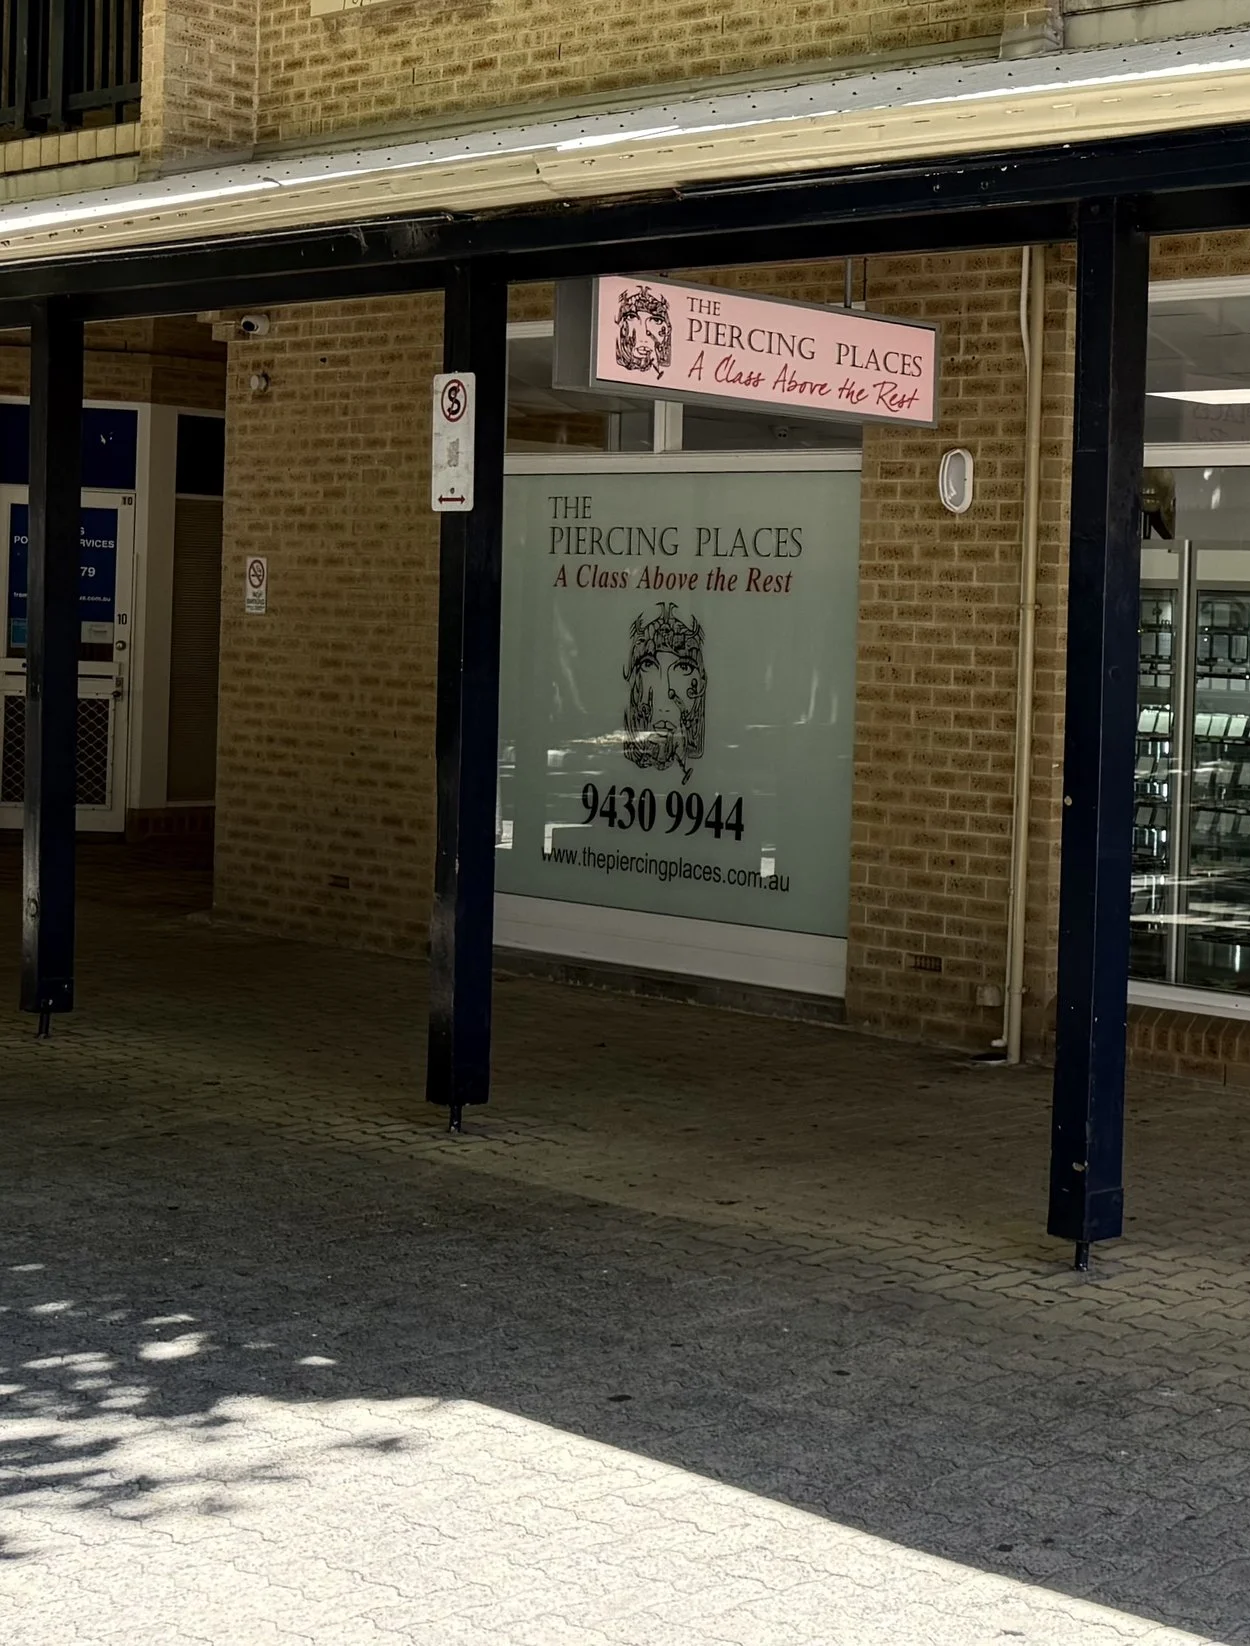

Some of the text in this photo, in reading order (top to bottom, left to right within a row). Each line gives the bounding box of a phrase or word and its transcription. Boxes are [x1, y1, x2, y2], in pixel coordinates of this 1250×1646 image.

[687, 297, 721, 316] THE
[686, 317, 923, 378] PIERCING PLACES
[688, 350, 921, 413] A Class Above the Rest
[548, 496, 592, 520] THE
[14, 535, 115, 549] PO RVICES
[548, 526, 803, 558] PIERCING PLACES
[80, 566, 96, 577] 79
[553, 564, 793, 593] A Class Above the Rest
[117, 613, 128, 625] 10
[581, 783, 745, 841] 9430 9944
[541, 845, 791, 893] www.thepiercingplaces.com.au
